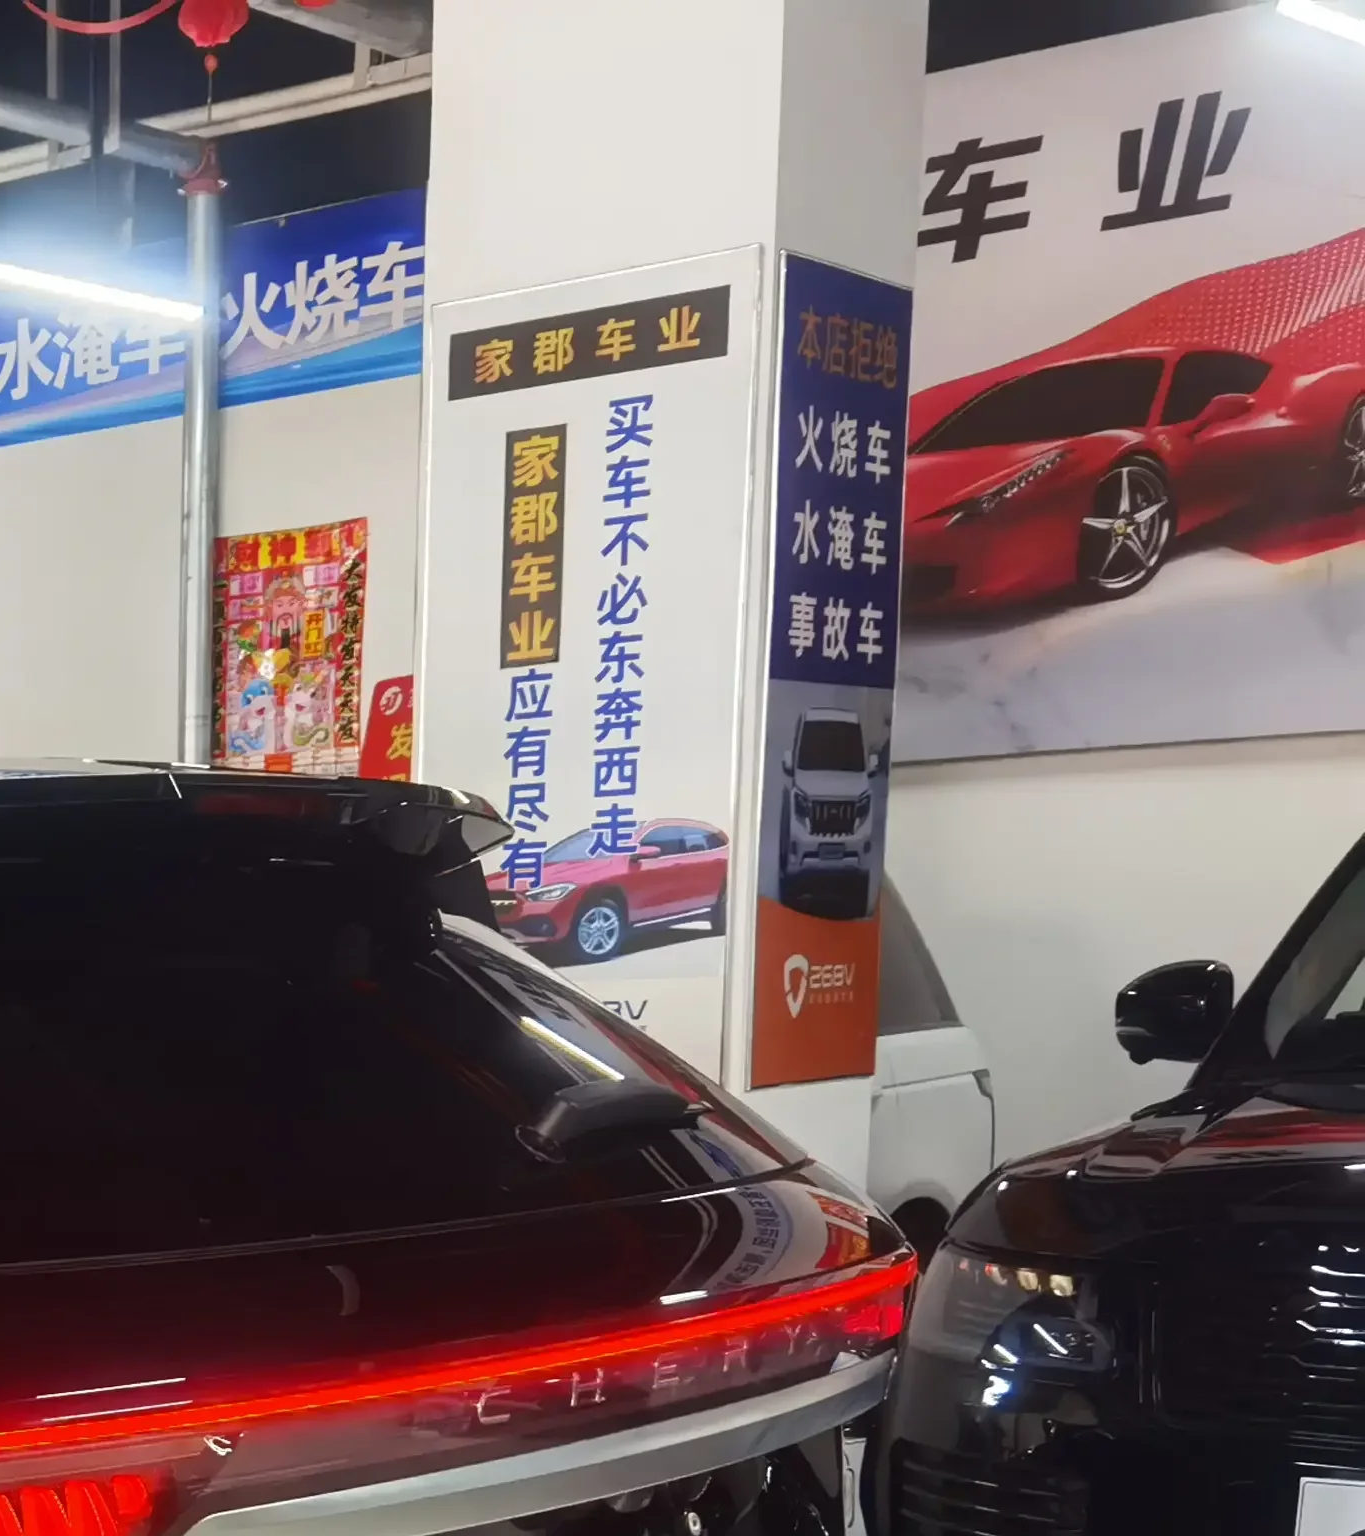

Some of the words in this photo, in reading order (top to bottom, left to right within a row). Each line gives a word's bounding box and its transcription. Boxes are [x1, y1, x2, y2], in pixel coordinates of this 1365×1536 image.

[918, 91, 1251, 263] 车业
[220, 241, 425, 360] 火烧车
[472, 304, 703, 387] 家郡车业
[797, 303, 899, 390] 本店拒绝
[794, 409, 893, 485] 火烧车
[506, 433, 561, 663] 家郡车业
[791, 498, 889, 575] 水淹车
[586, 393, 655, 857] 买车不必东奔西走
[788, 592, 885, 666] 事故车
[499, 668, 553, 890] 应有尽有
[809, 962, 856, 989] 268V
[476, 1323, 802, 1426] CHERY
